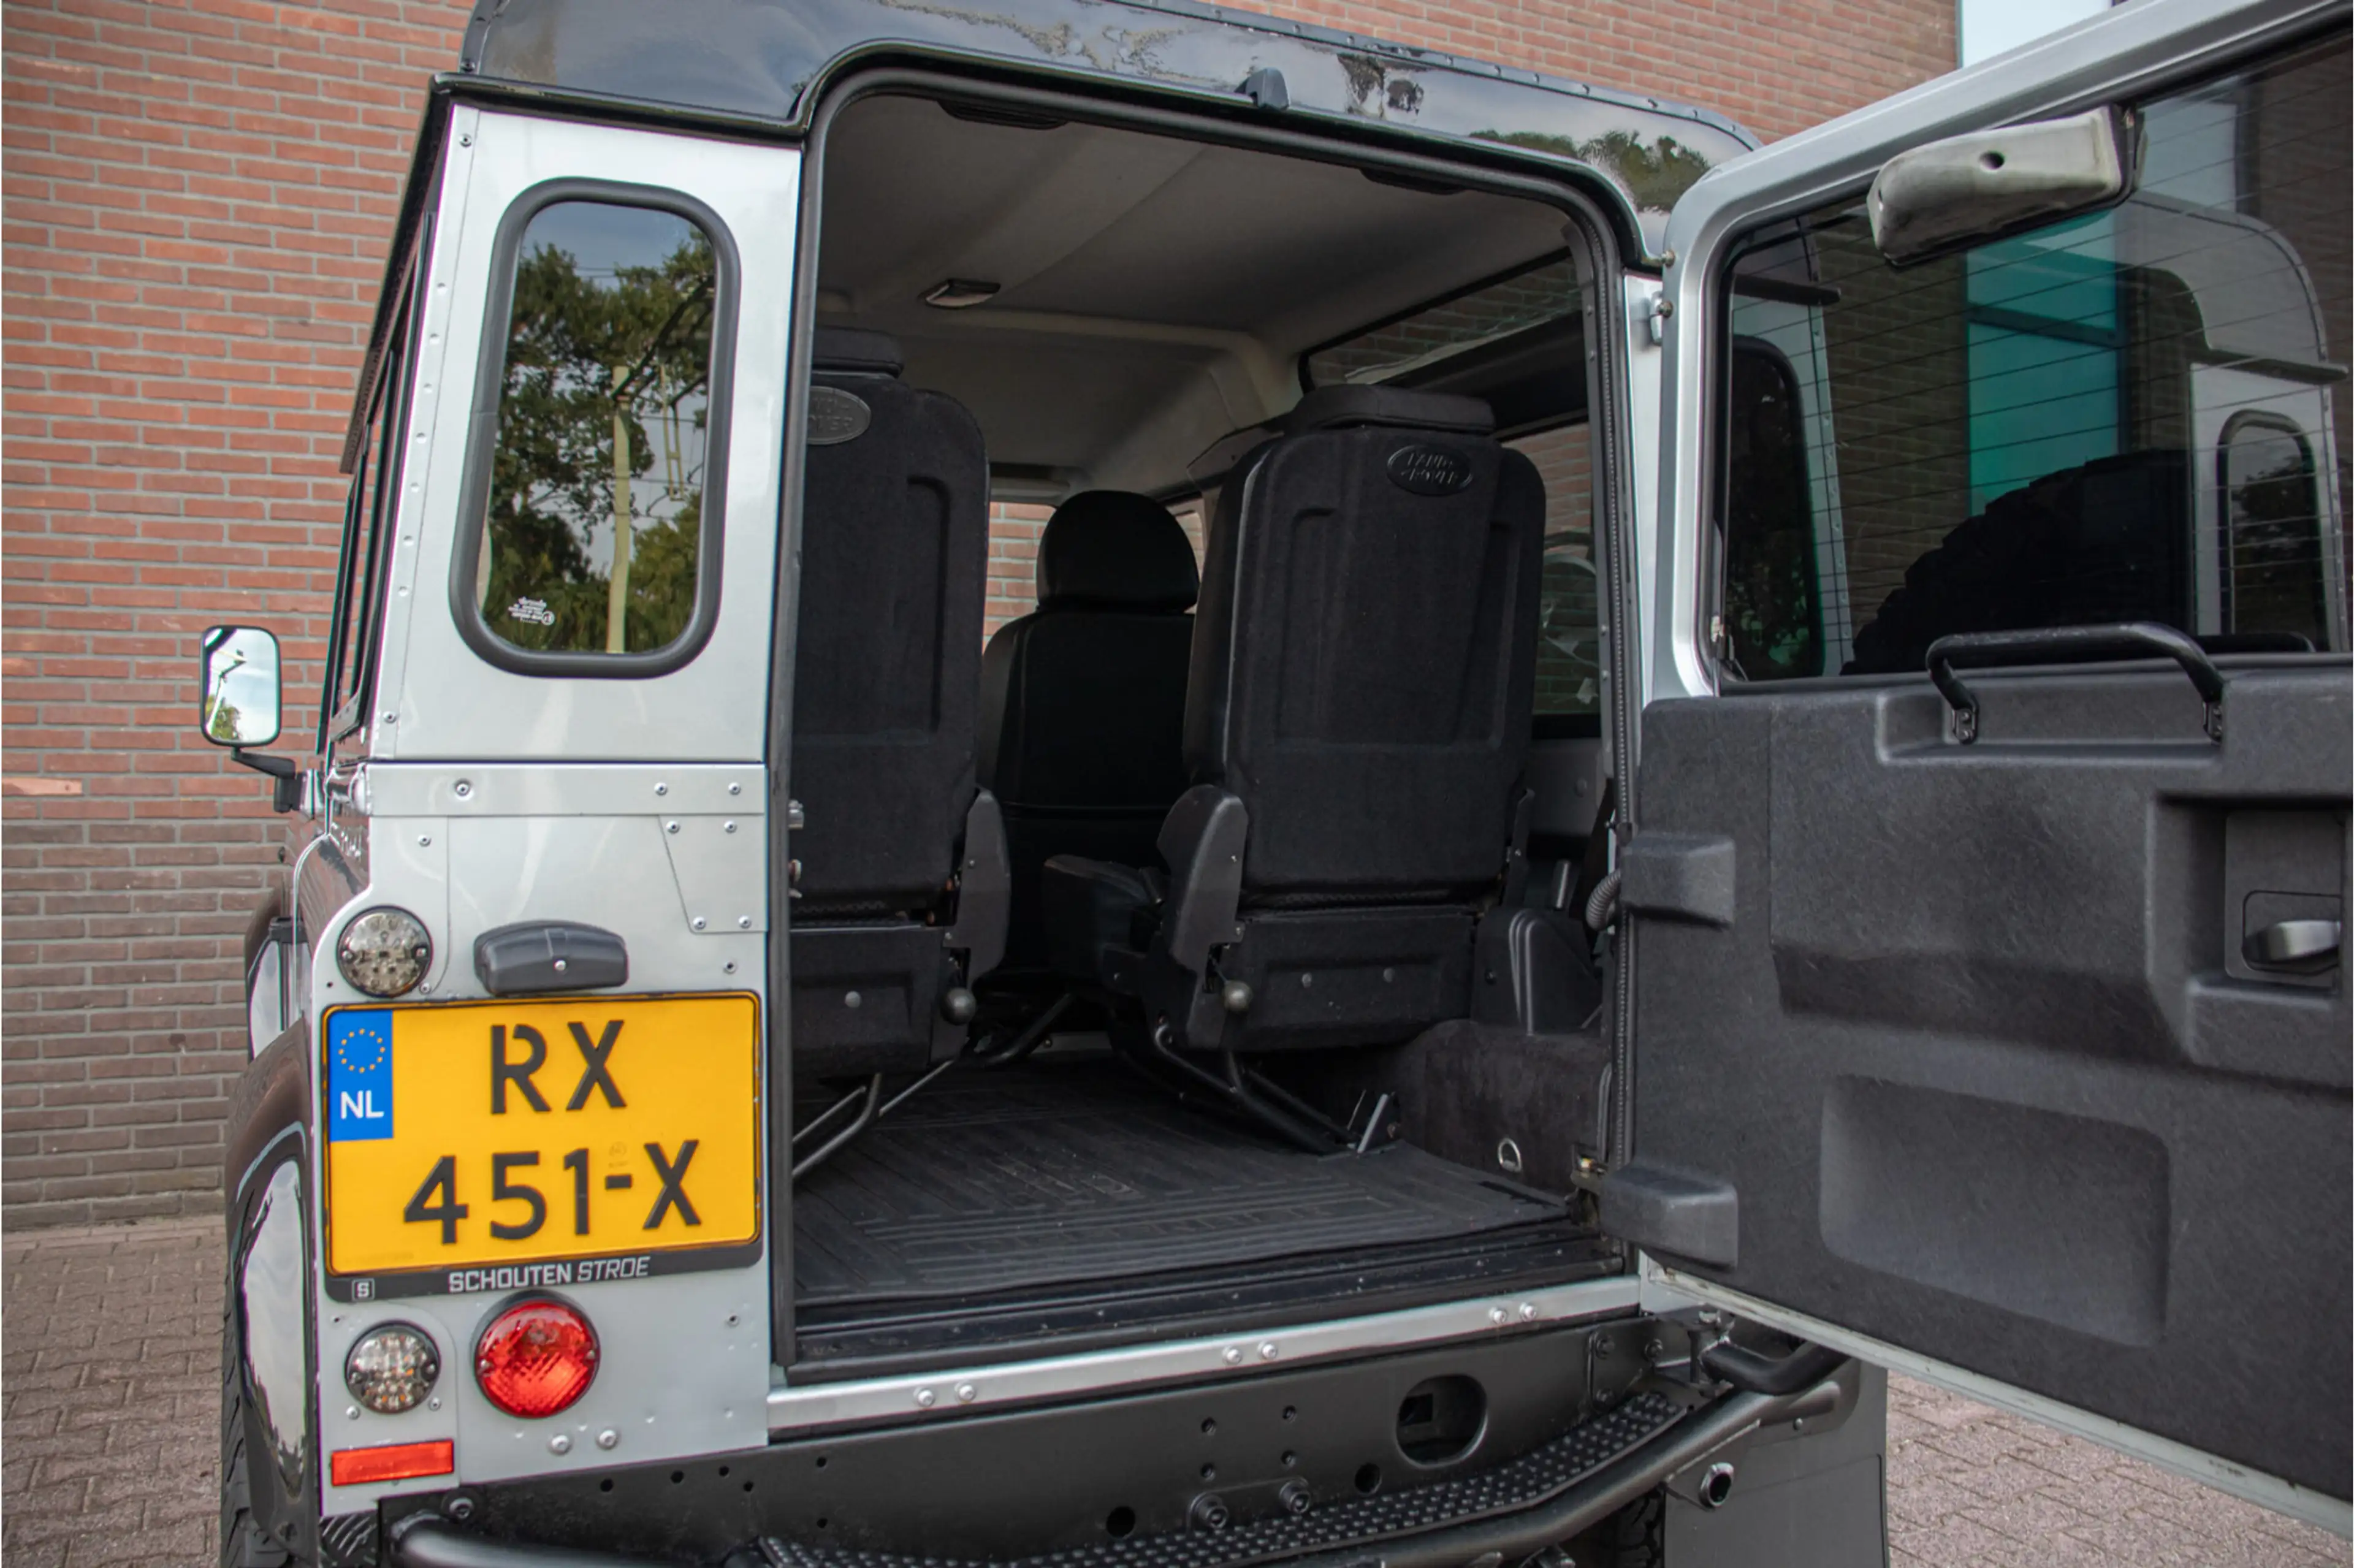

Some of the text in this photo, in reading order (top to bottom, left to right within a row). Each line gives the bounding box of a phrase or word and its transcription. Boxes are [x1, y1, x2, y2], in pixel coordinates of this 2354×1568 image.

[490, 1019, 627, 1114] RX
[341, 1090, 384, 1119] NL
[403, 1140, 701, 1245] 451-X
[448, 1256, 651, 1293] SCHOUTEN STROE
